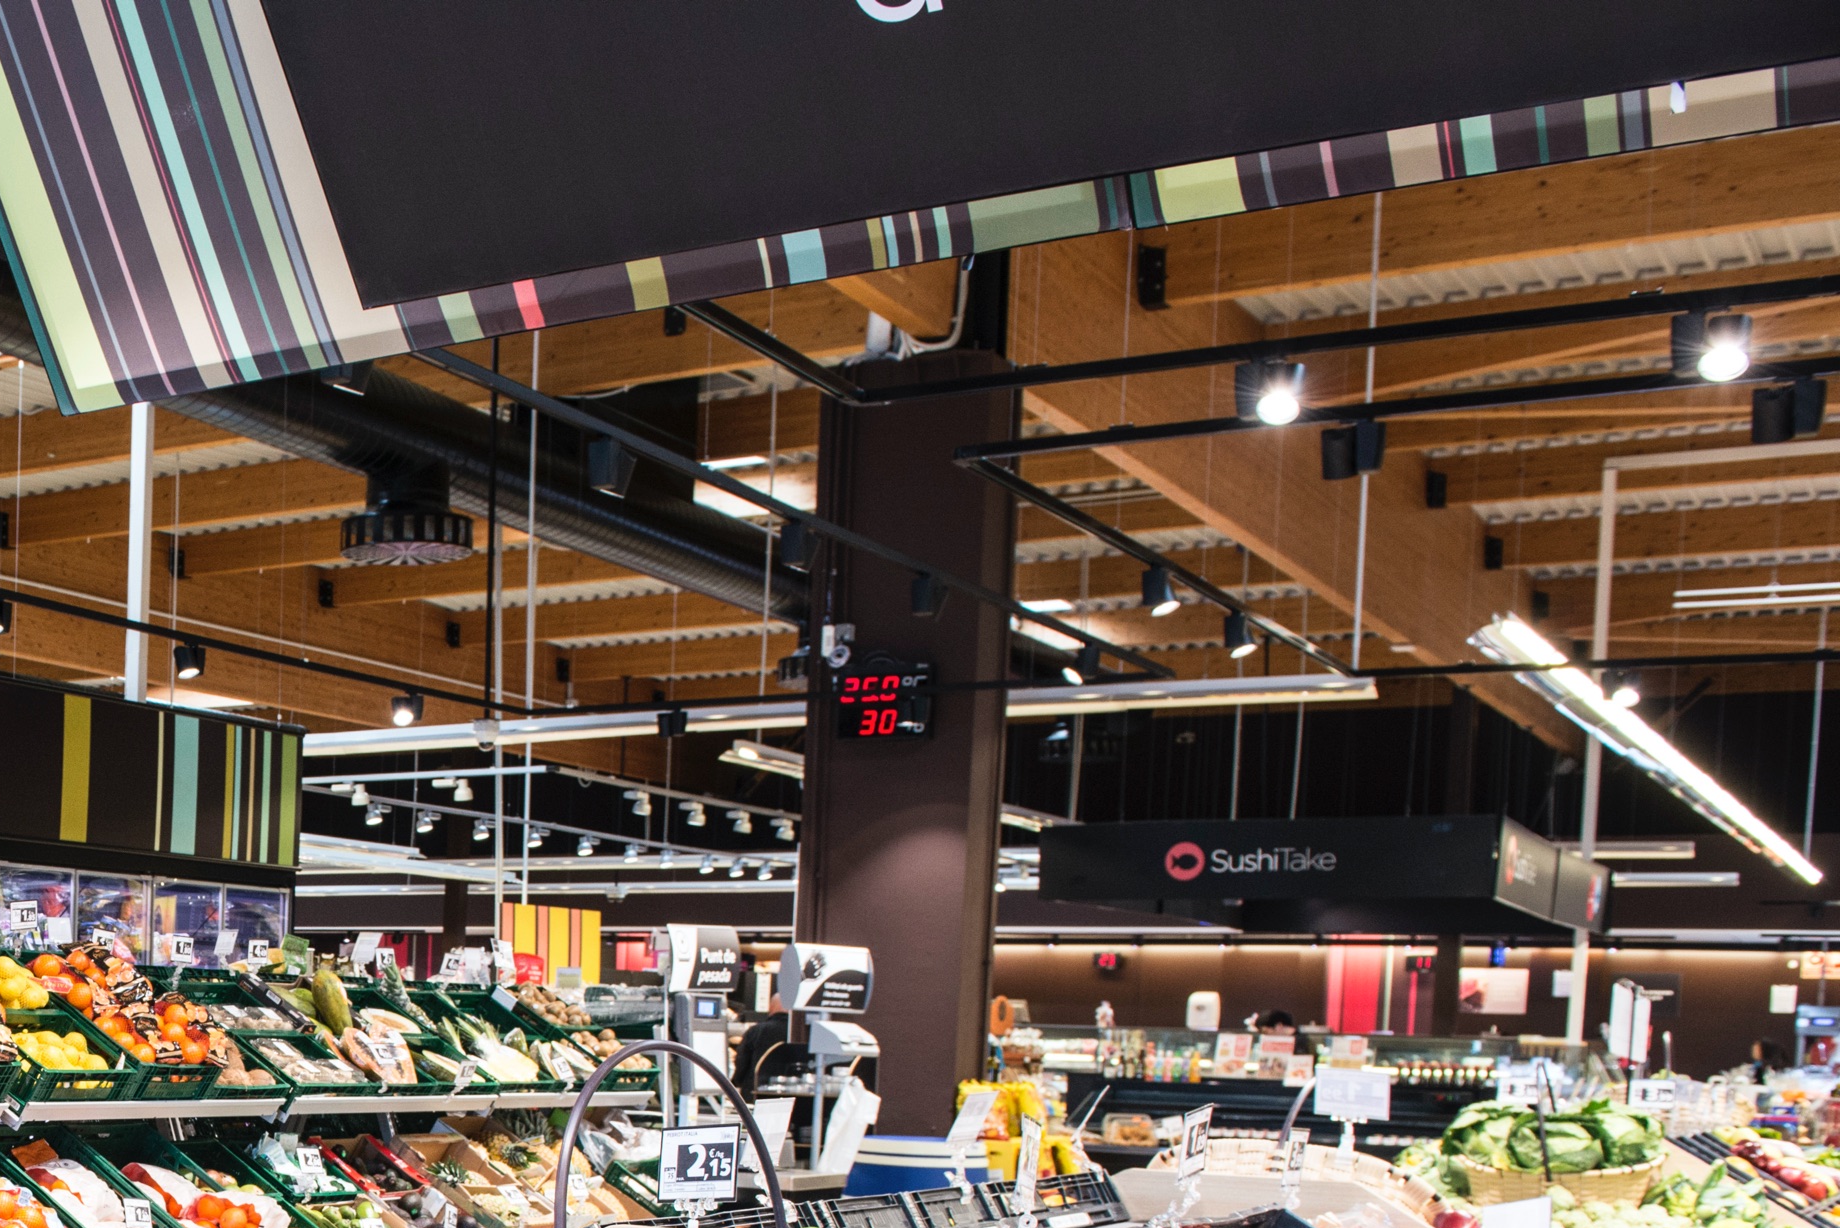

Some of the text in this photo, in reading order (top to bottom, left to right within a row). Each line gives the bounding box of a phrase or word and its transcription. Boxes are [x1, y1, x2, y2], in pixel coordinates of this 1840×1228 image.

[859, 709, 898, 736] 30
[1211, 848, 1336, 873] SushiTake
[700, 947, 737, 964] Punt de
[697, 967, 732, 986] pesada
[686, 1143, 731, 1181] 2,15
